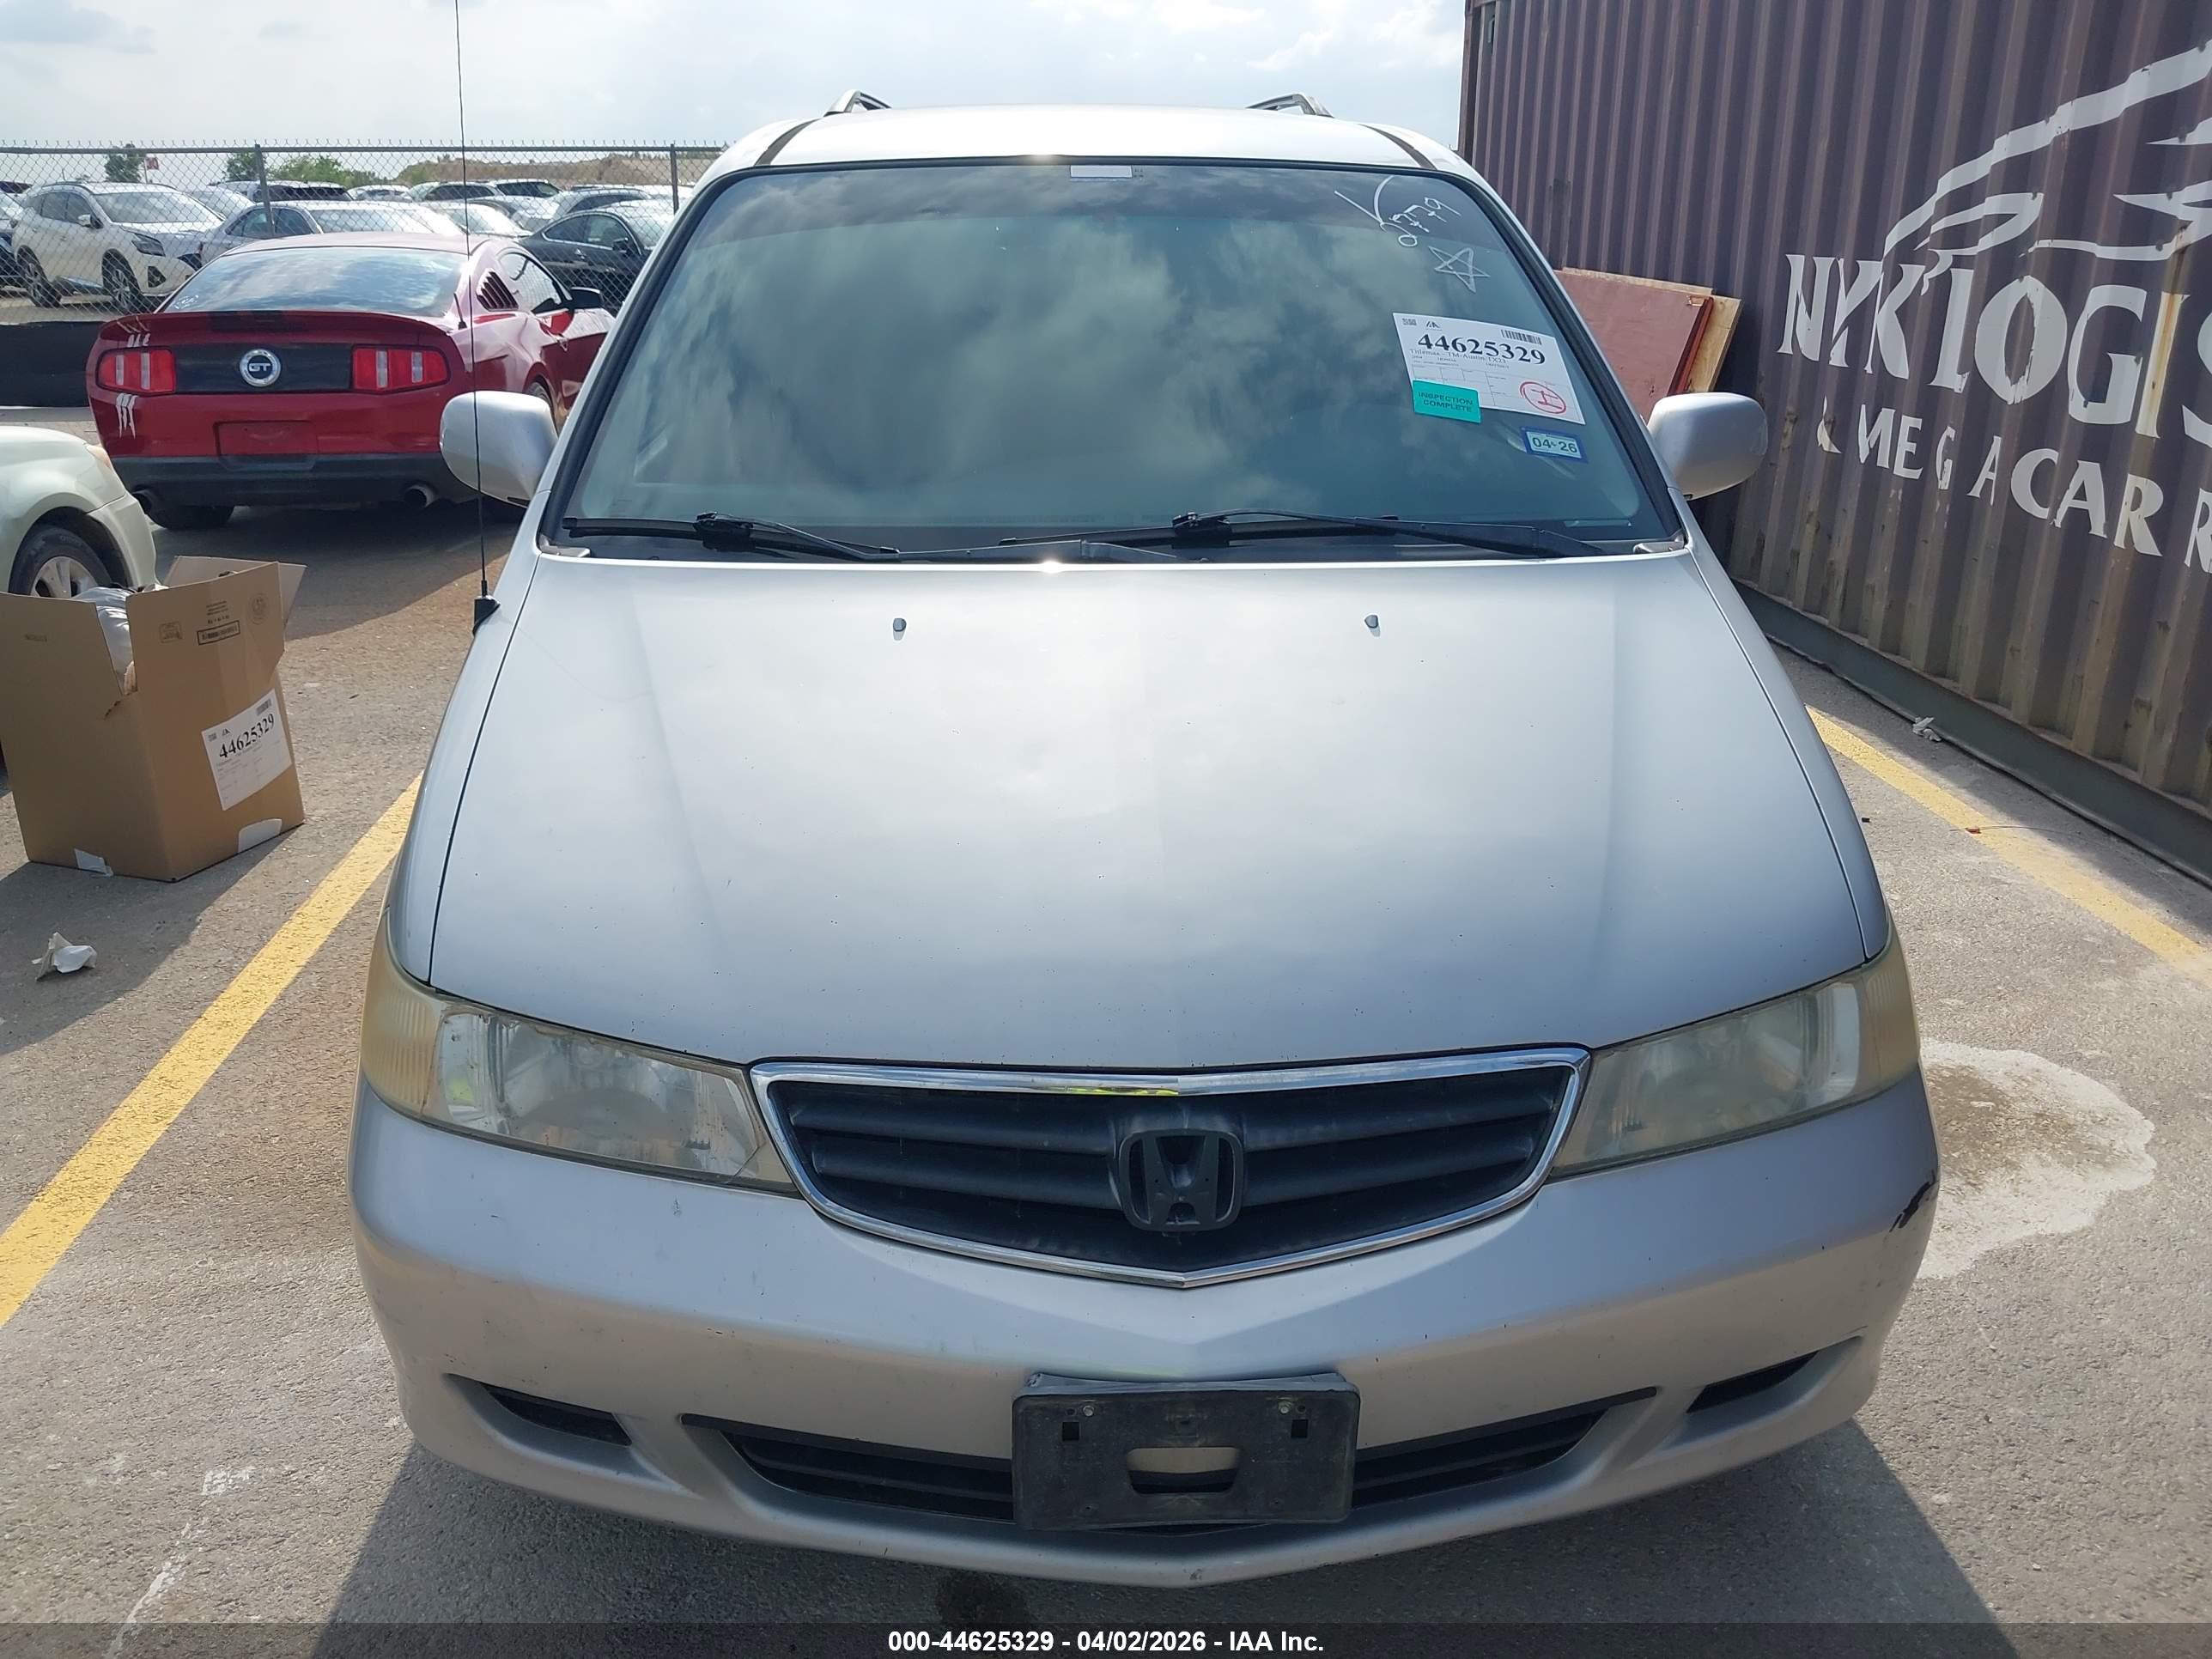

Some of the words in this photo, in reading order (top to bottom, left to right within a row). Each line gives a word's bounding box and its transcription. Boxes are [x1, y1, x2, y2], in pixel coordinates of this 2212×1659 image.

[1777, 254, 1925, 380] NYK
[1418, 333, 1546, 365] 44625329
[249, 362, 270, 371] GT
[1418, 392, 1474, 405] INSPECTION
[1423, 399, 1472, 412] COMPLETE
[219, 714, 274, 758] 44625329
